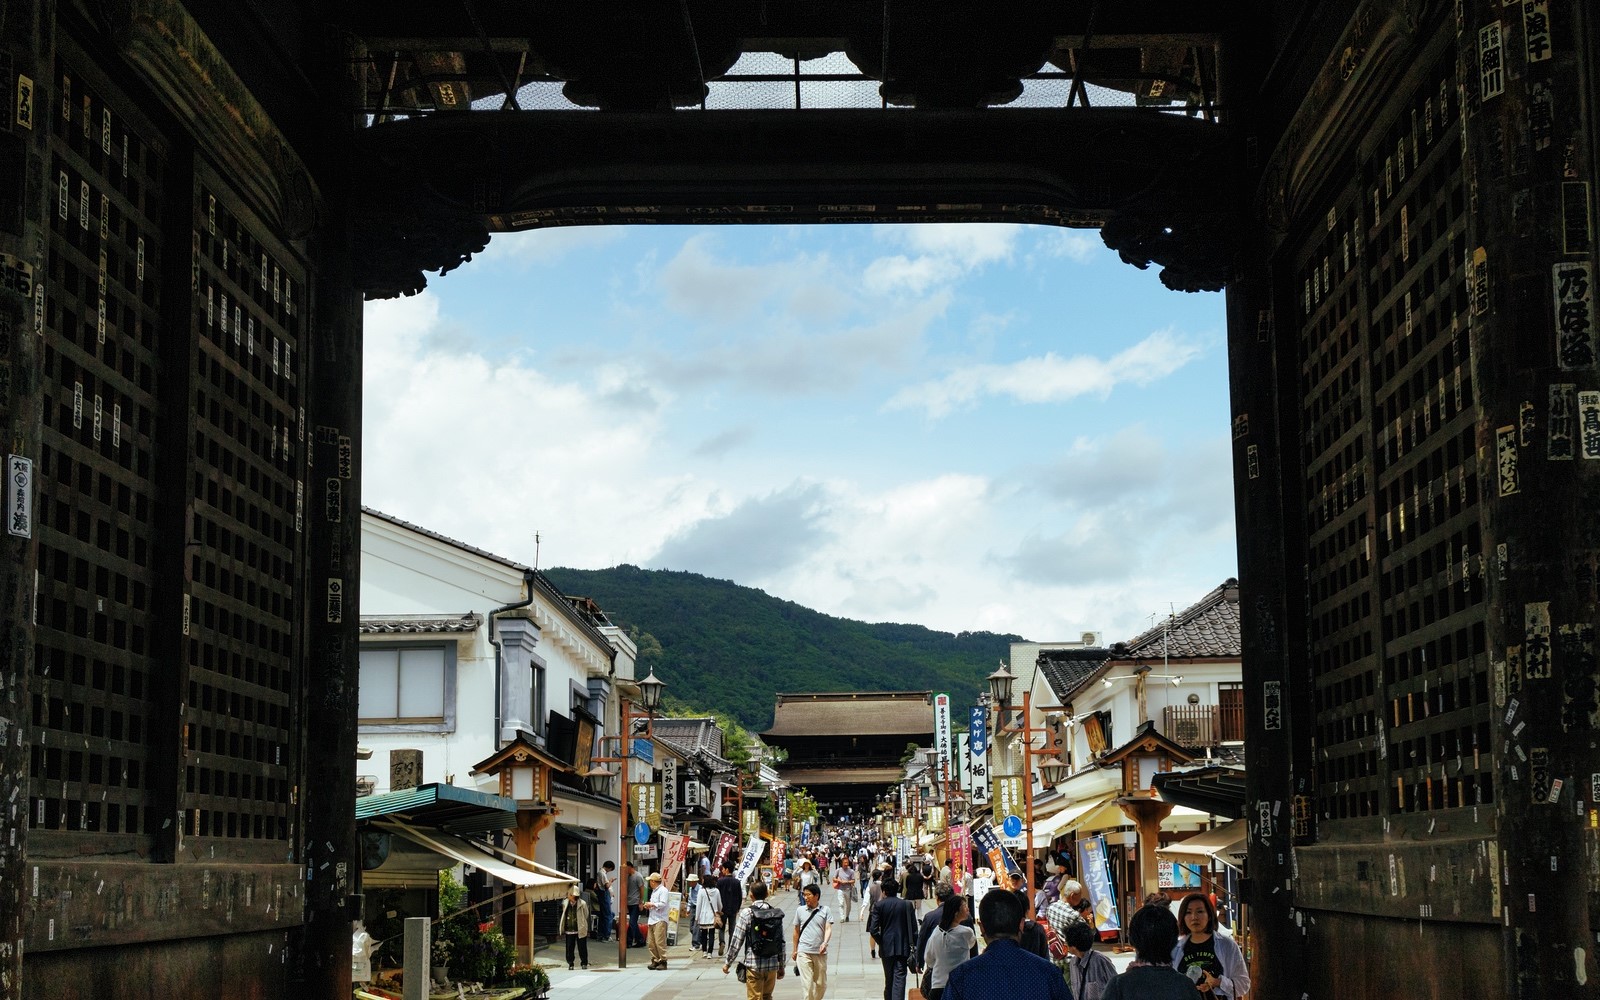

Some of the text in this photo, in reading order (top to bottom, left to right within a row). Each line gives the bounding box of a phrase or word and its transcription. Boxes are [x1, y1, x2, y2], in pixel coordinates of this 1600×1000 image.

[664, 762, 675, 810] いづみや旅館
[972, 764, 986, 800] 柏屋
